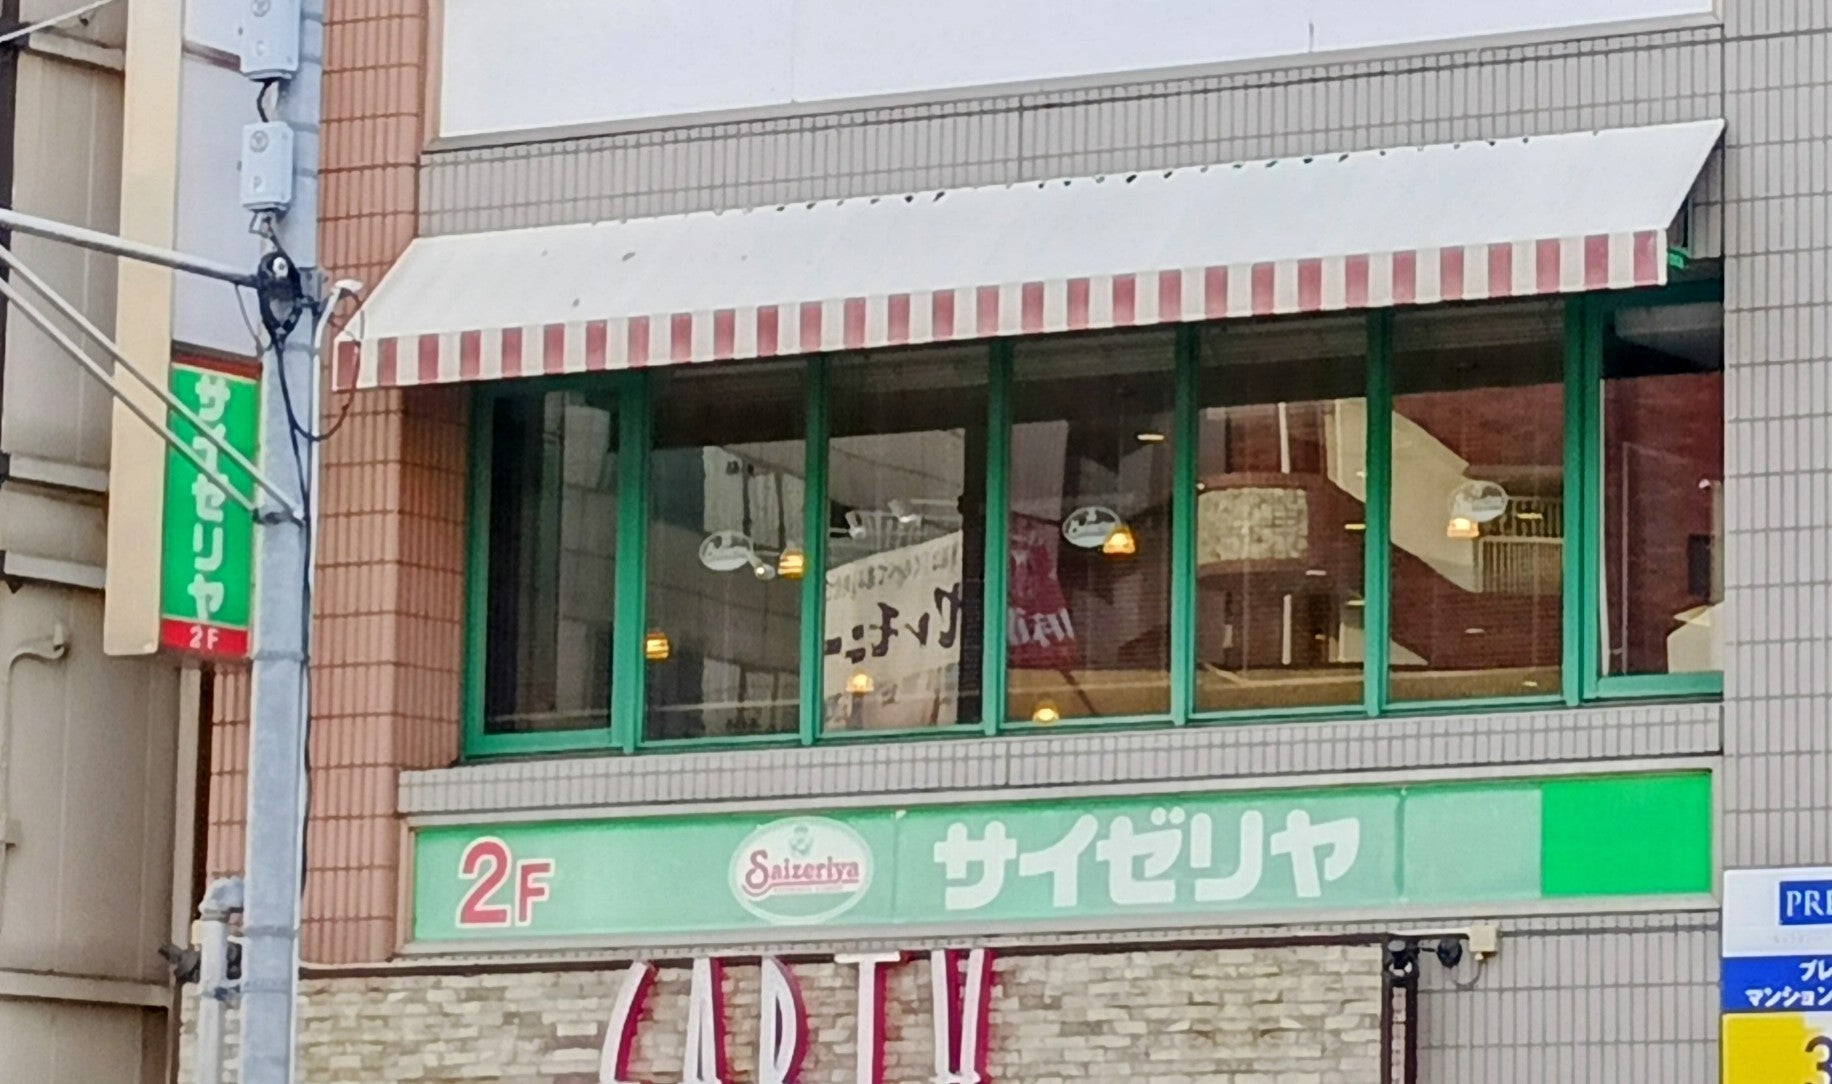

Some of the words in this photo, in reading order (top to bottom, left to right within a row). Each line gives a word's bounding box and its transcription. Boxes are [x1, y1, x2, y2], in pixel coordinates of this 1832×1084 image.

[189, 625, 219, 650] 2F
[456, 836, 555, 928] 2F
[742, 849, 860, 896] Saizeriya
[934, 807, 1360, 910] サイゼリヤ
